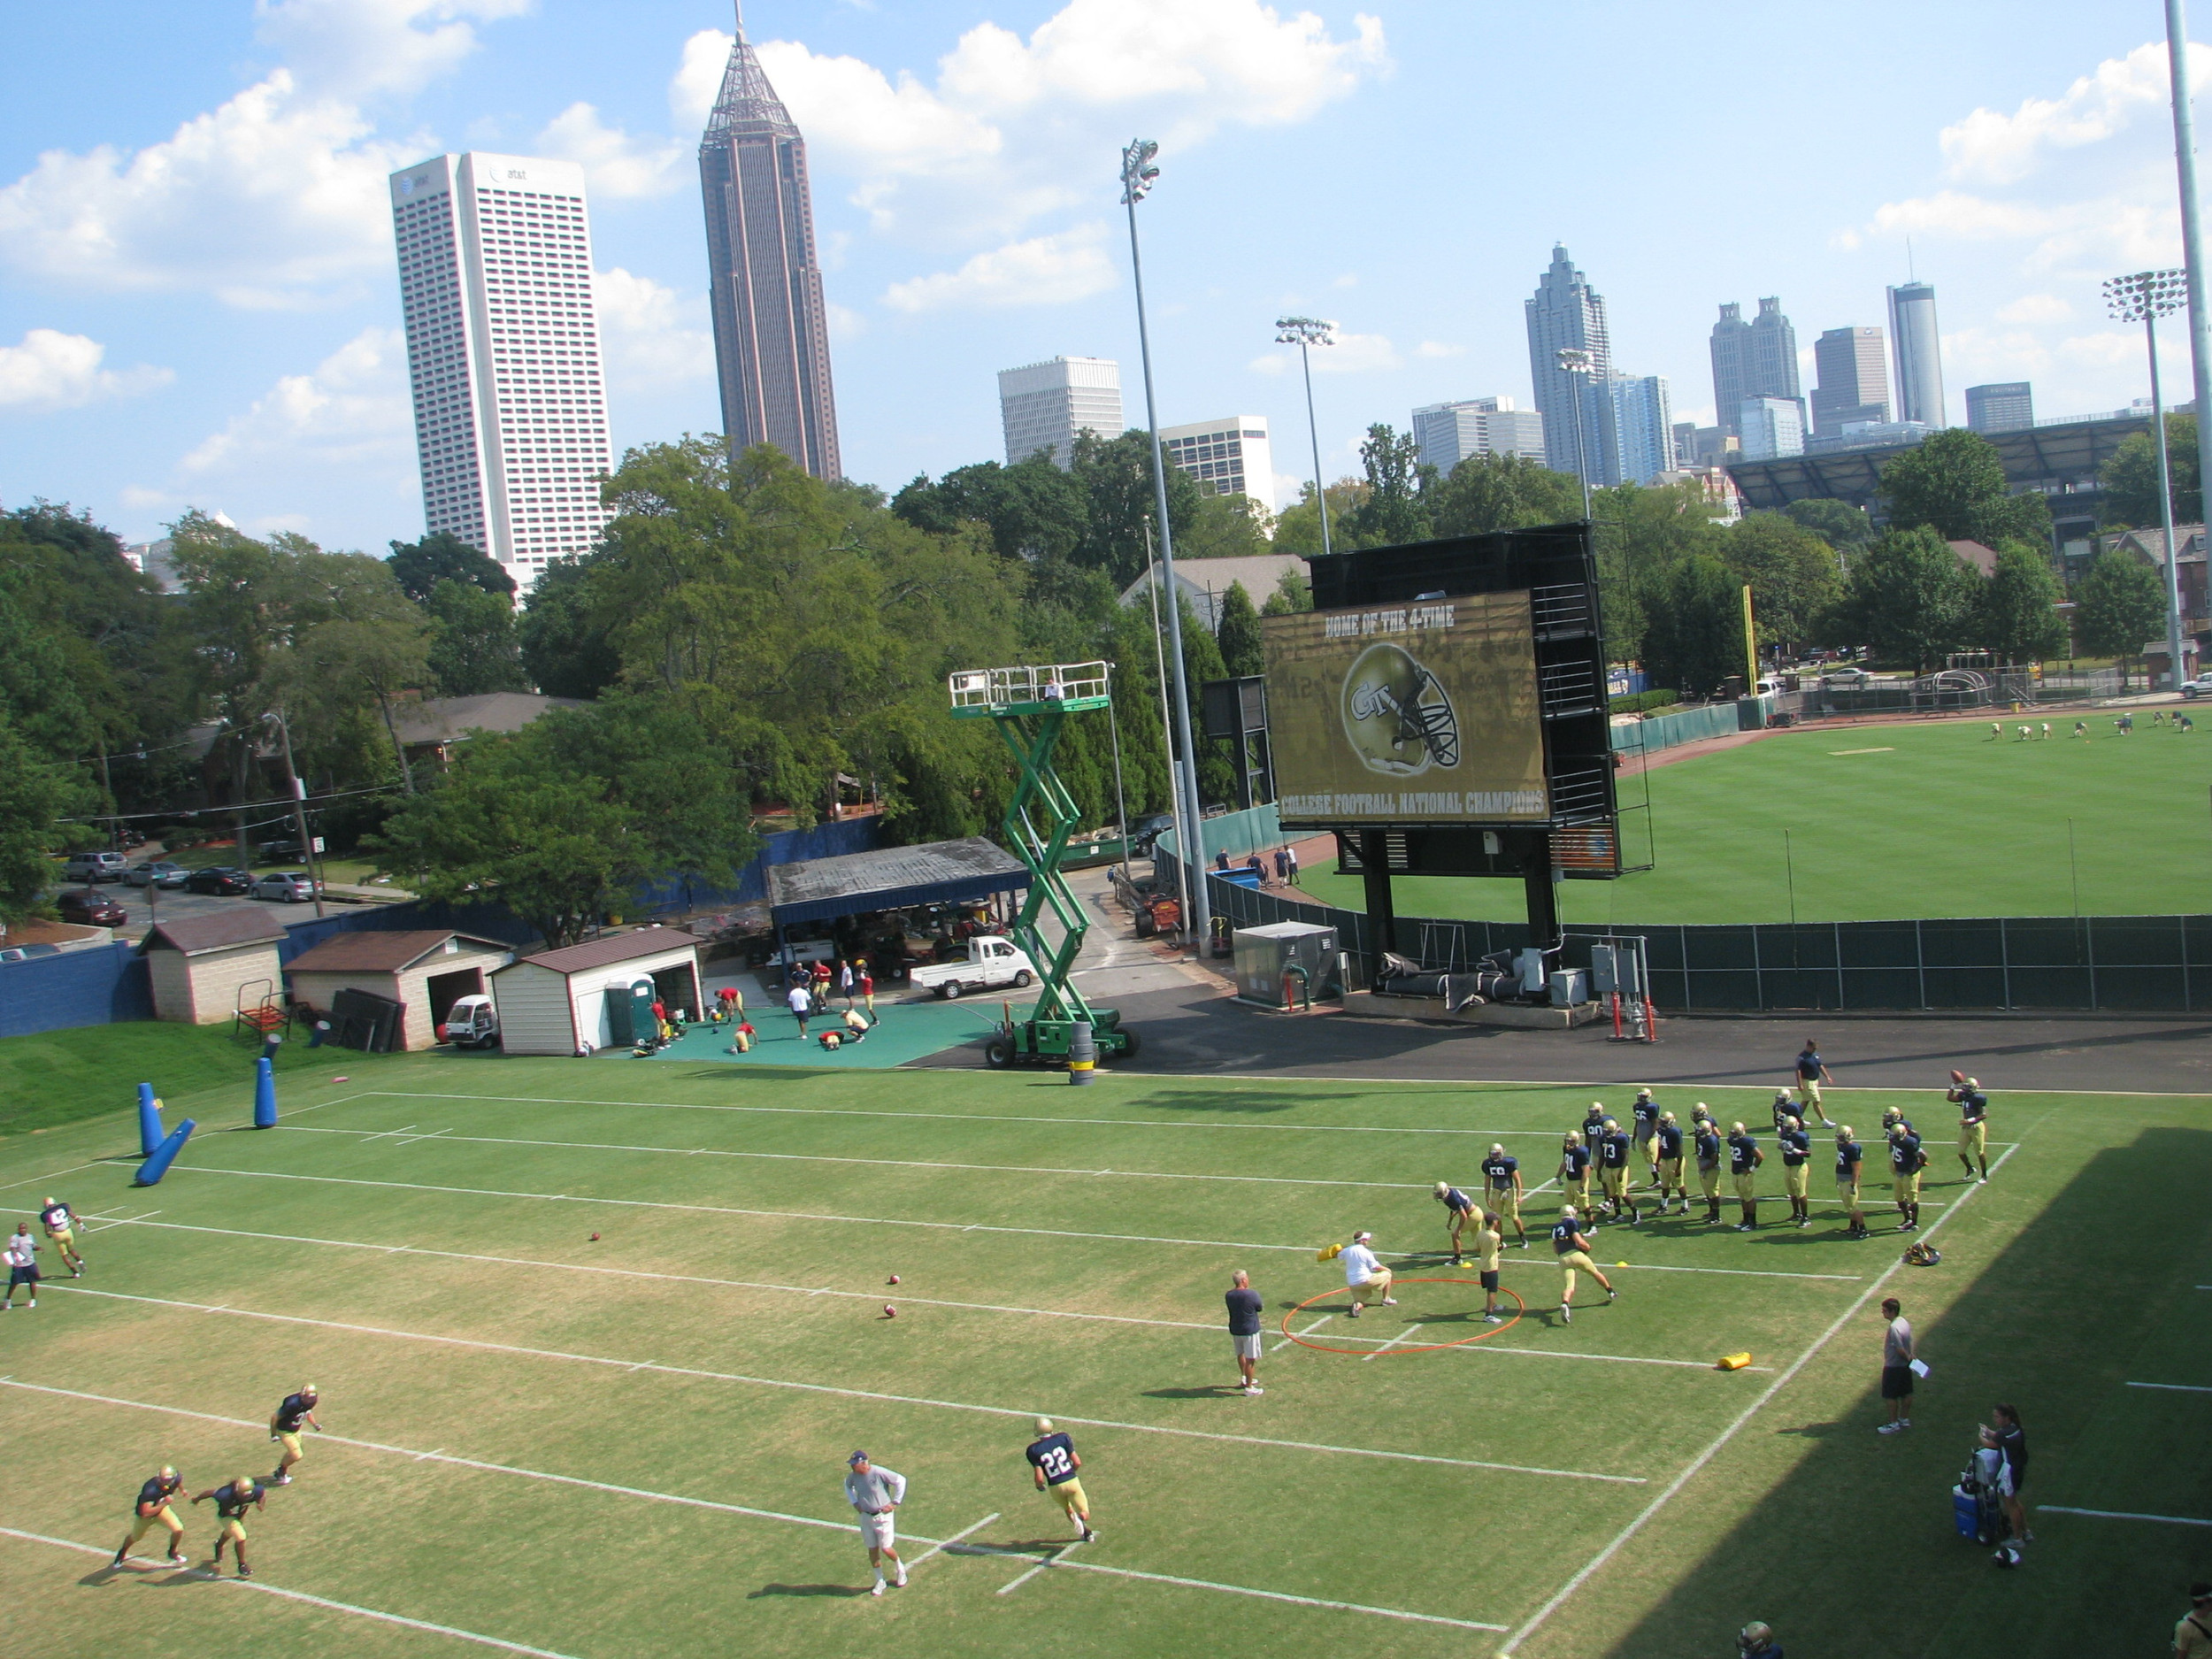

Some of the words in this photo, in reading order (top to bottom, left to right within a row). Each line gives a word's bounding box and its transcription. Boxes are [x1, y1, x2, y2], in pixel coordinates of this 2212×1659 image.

[508, 169, 527, 180] at&t
[1325, 614, 1359, 637] HOME
[1363, 612, 1378, 634] OF
[1381, 610, 1407, 632] THE
[1409, 604, 1455, 630] 4-TIME
[1282, 795, 1332, 815] COLLEGE
[1334, 793, 1395, 814] FOOTBALL
[1400, 792, 1463, 813] NATIONAL
[1465, 790, 1545, 813] CHAMPIONS
[1602, 1143, 1616, 1159] 73
[1040, 1446, 1071, 1479] 22
